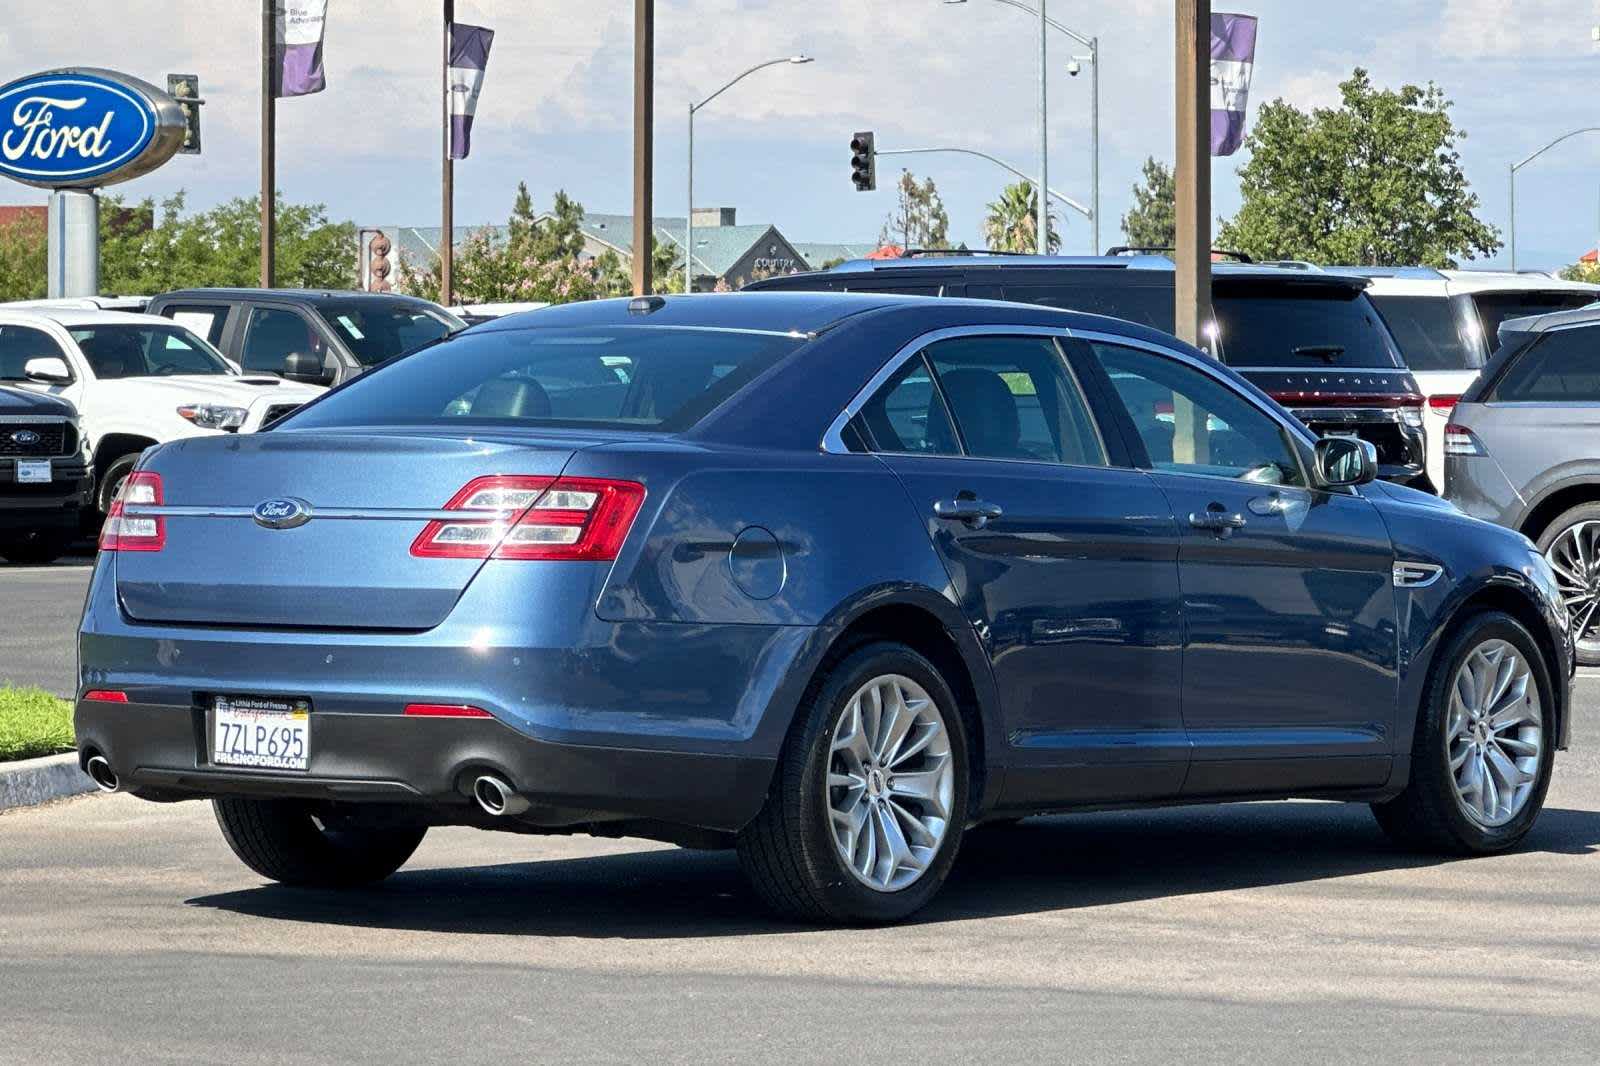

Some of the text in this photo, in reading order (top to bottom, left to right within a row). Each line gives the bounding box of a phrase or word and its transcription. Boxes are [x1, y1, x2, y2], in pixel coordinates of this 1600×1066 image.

[2, 96, 115, 160] Ford
[262, 501, 291, 516] Ford
[251, 700, 263, 709] Ford
[219, 722, 304, 759] 7ZLP695
